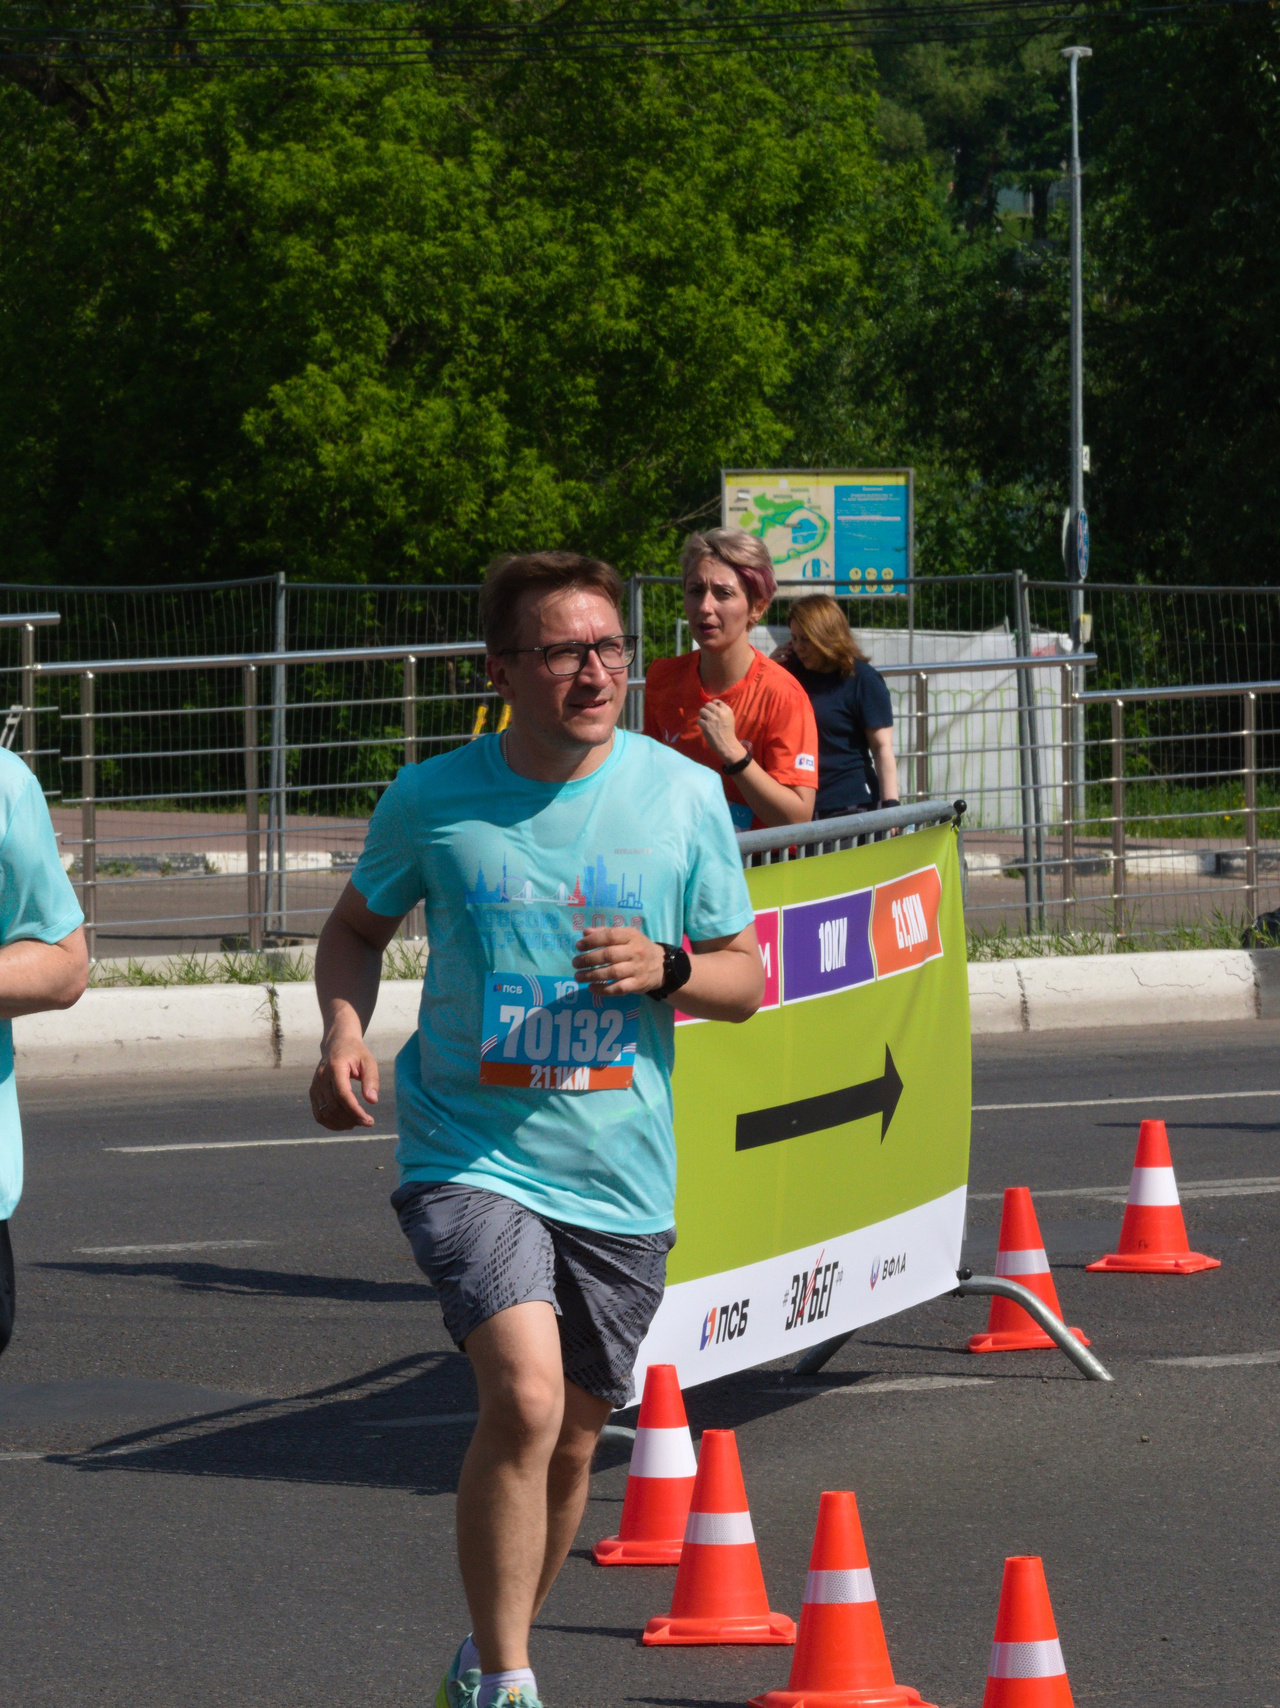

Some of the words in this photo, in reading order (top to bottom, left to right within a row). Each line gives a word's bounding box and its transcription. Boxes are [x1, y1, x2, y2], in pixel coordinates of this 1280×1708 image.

[502, 984, 523, 994] ПСБ
[499, 1004, 624, 1063] 70132
[882, 1252, 906, 1280] ВФЛА
[716, 1298, 750, 1345] ПСБ
